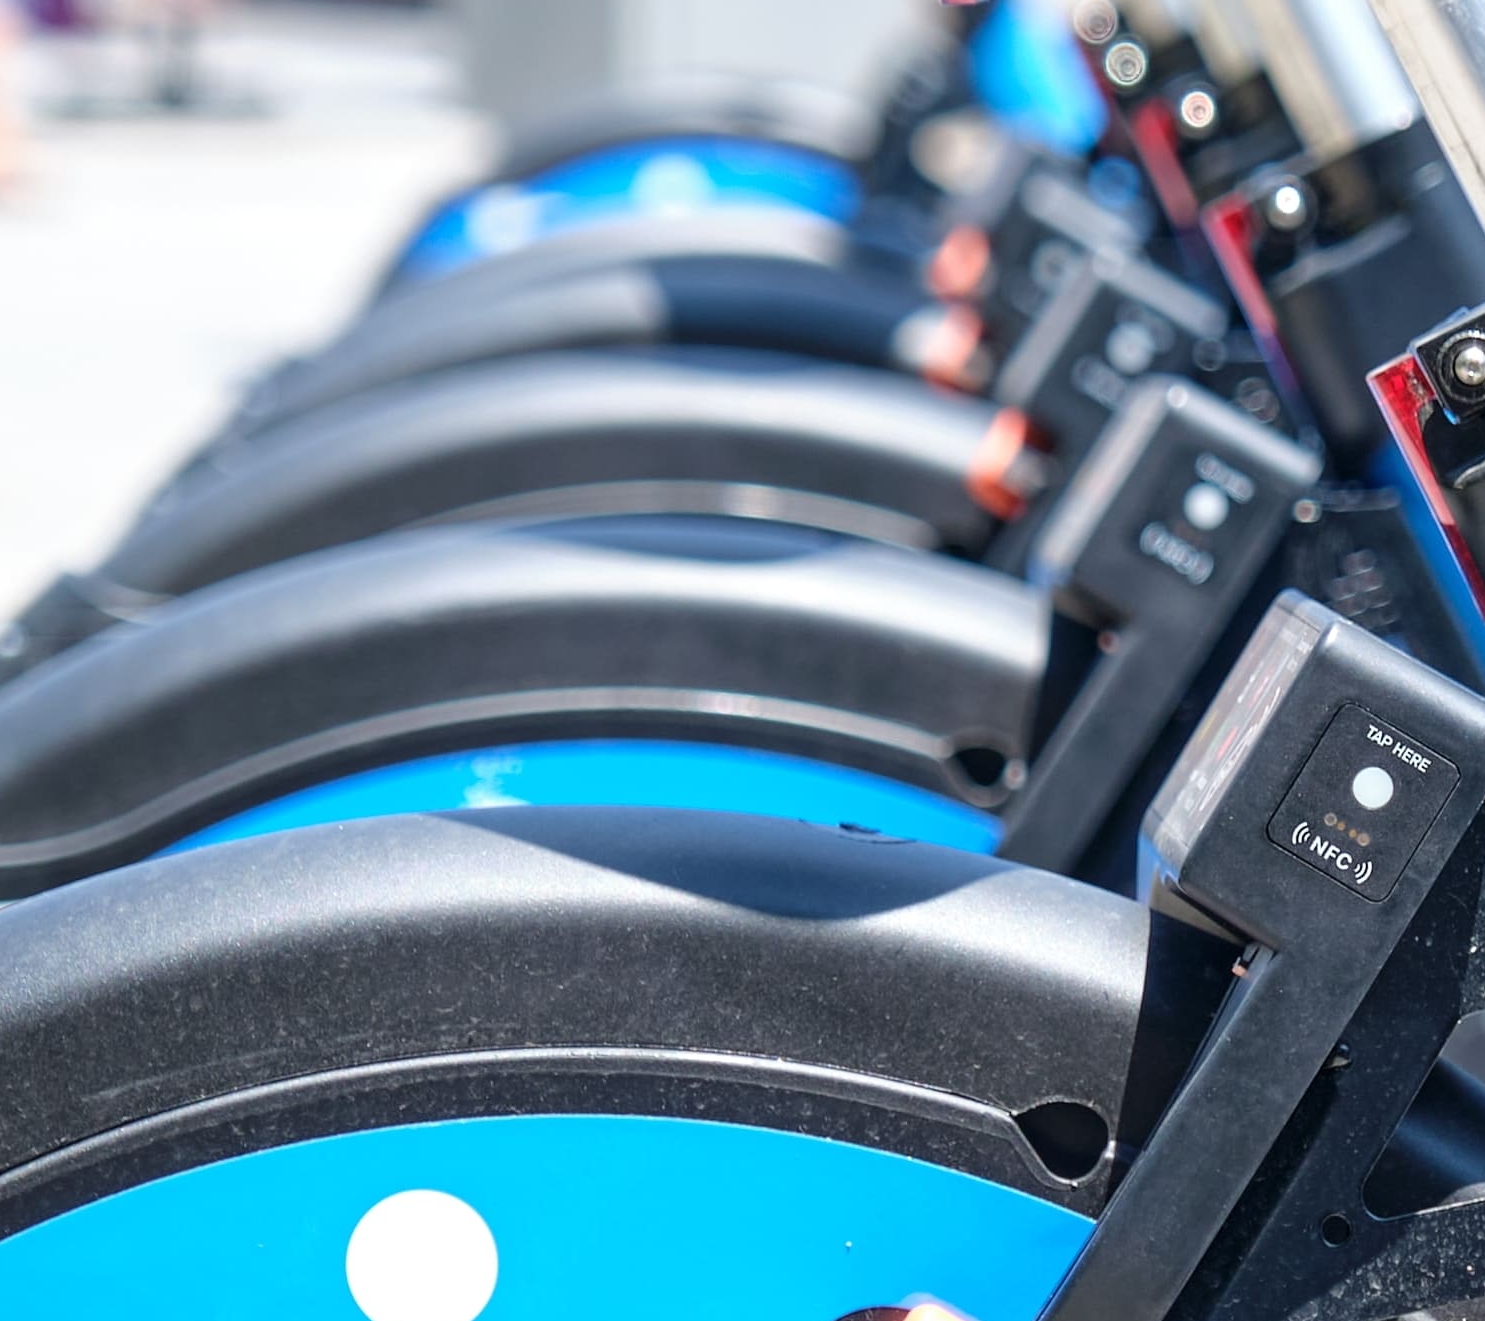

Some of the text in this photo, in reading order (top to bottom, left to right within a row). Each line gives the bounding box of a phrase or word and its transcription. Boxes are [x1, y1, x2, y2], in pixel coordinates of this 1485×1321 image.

[1366, 724, 1432, 773] TAP HERE
[1309, 835, 1353, 871] NFC
